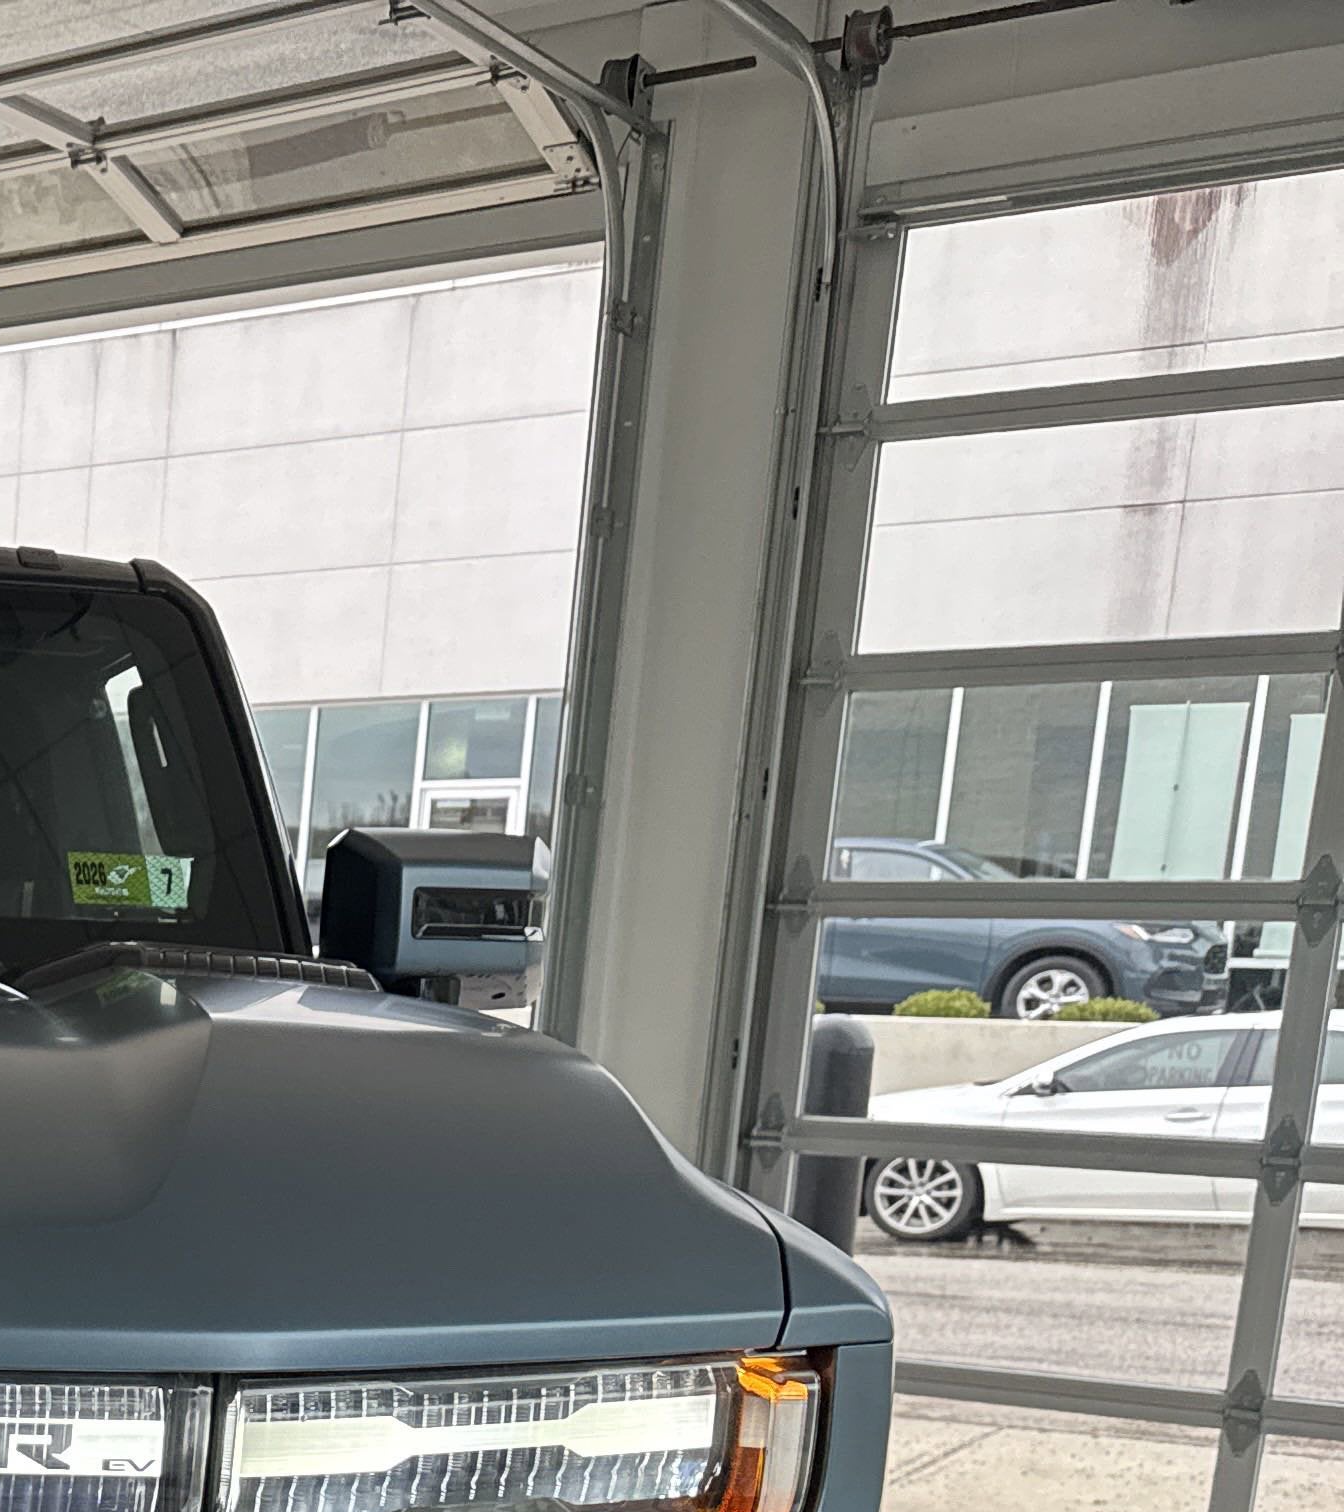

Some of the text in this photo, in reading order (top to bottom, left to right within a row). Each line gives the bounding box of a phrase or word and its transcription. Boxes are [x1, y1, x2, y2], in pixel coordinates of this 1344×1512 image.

[74, 862, 108, 885] 2026
[160, 868, 173, 897] 7
[102, 1459, 156, 1472] EV
